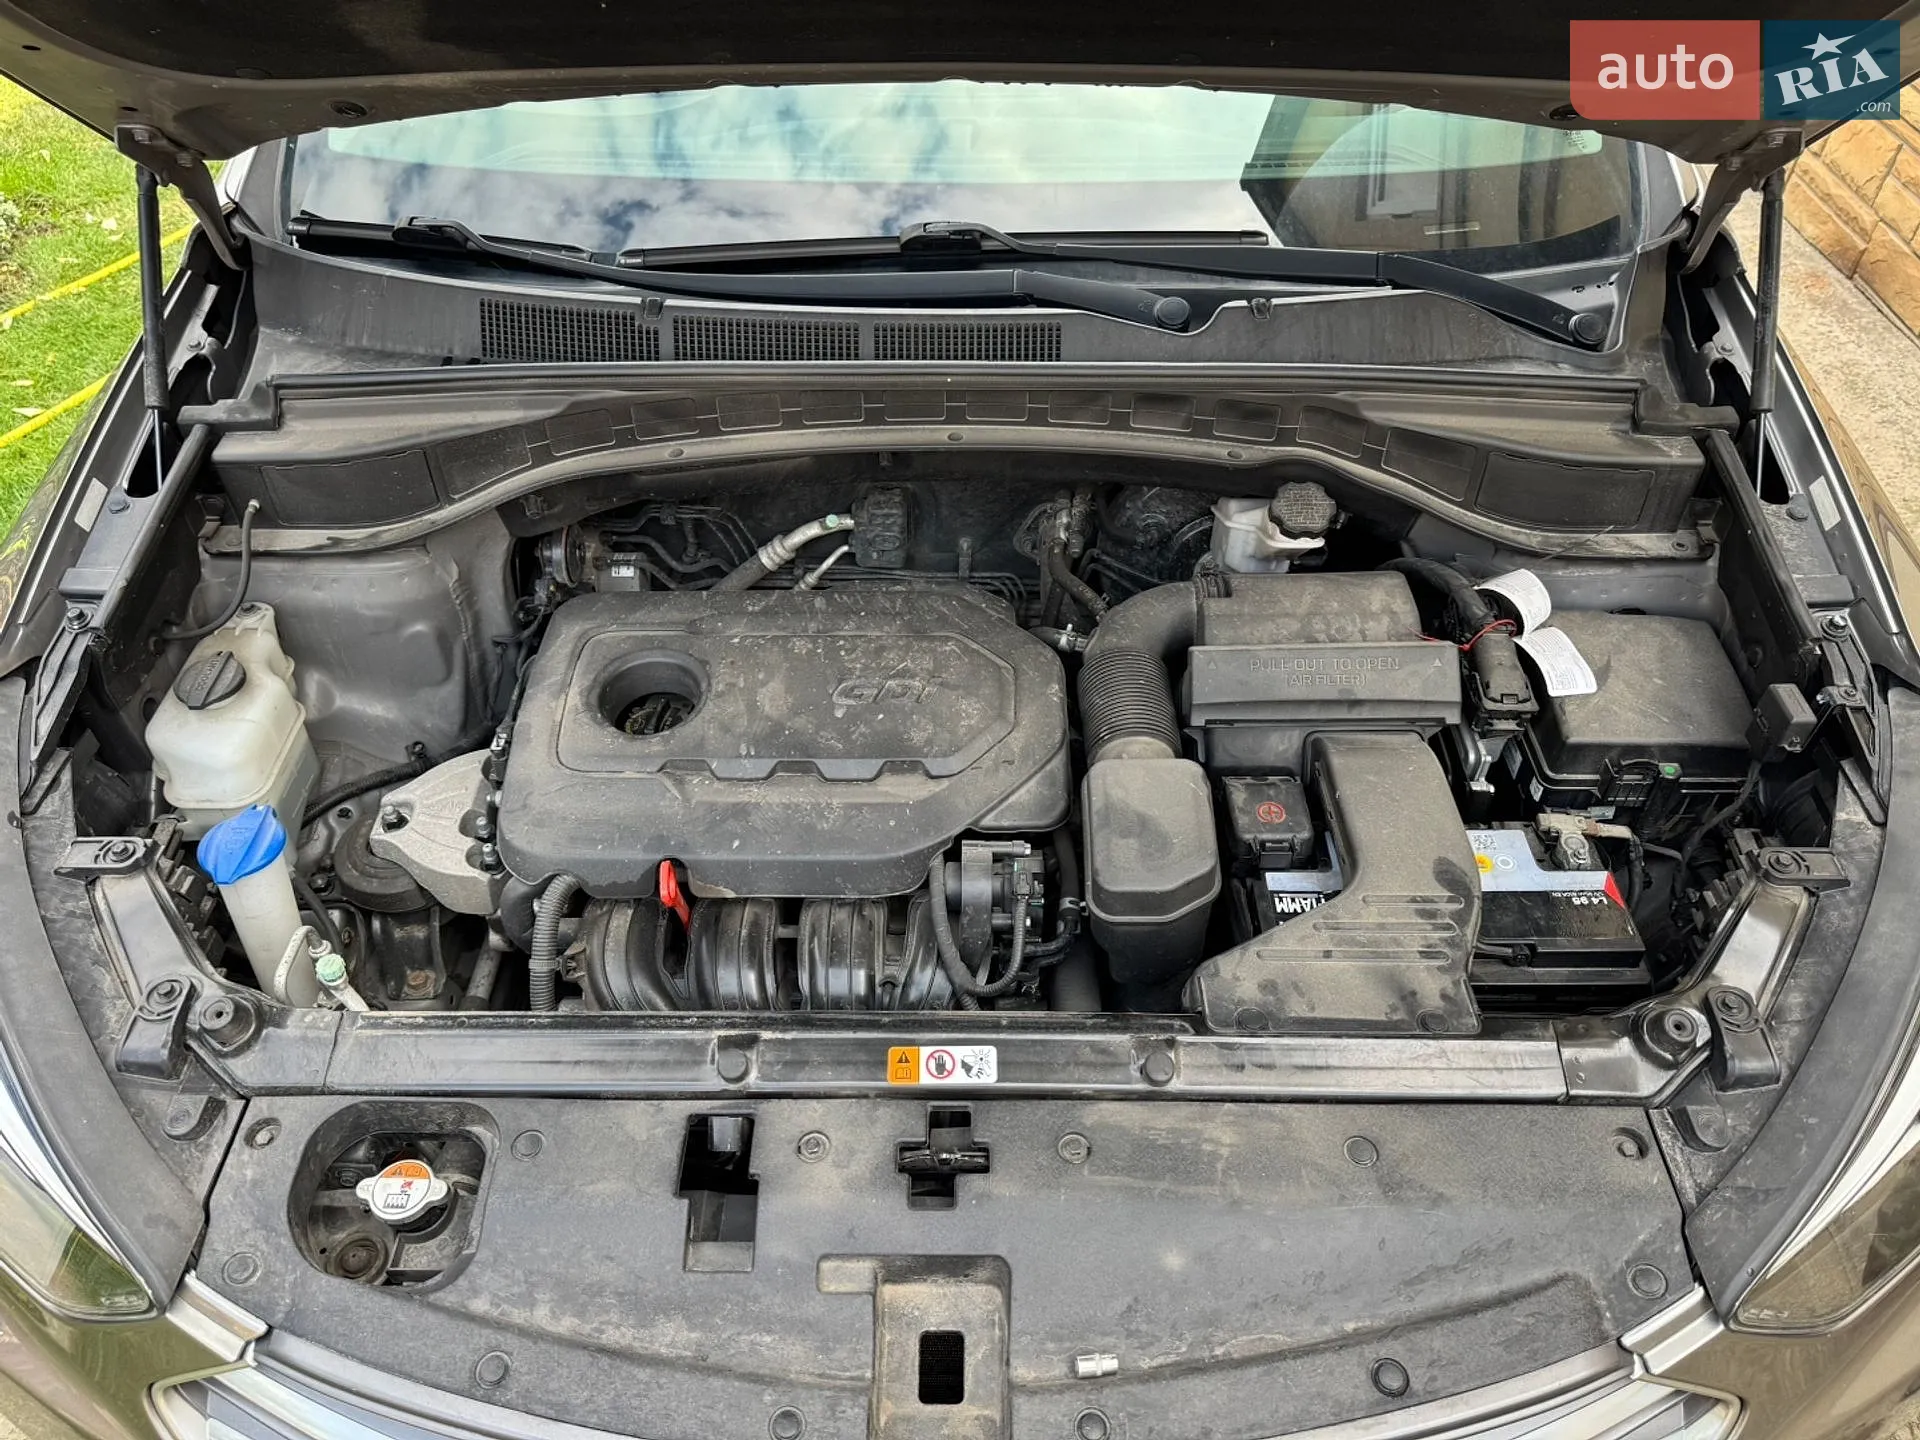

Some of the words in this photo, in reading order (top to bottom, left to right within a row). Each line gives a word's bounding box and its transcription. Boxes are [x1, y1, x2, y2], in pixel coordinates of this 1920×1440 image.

[1250, 658, 1289, 672] PULL
[1294, 658, 1325, 671] OUT
[1334, 658, 1351, 670] TO
[1355, 657, 1400, 670] OPEN
